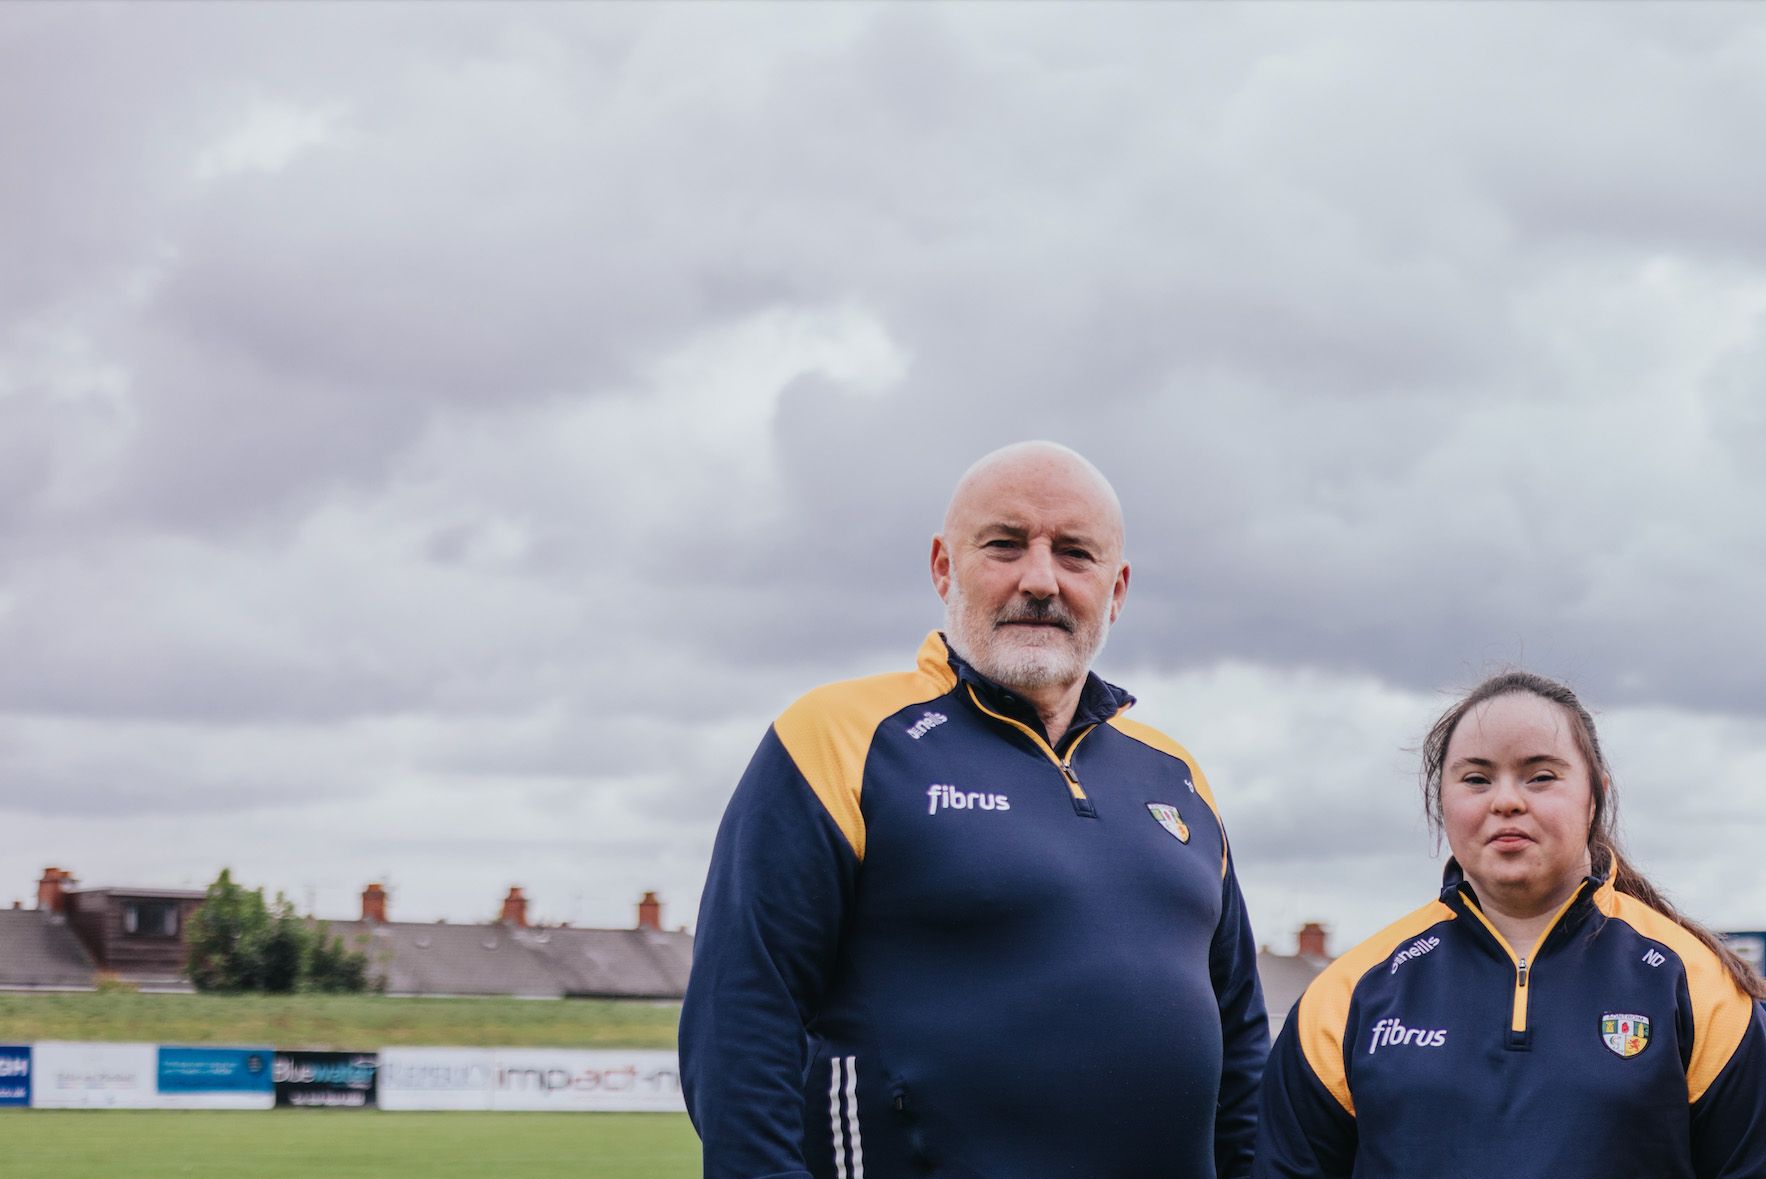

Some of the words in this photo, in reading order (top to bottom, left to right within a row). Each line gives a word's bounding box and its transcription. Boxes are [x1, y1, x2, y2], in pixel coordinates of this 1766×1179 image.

[926, 784, 1011, 816] fibrus
[1641, 948, 1665, 967] ND
[1369, 1018, 1447, 1054] fibrus
